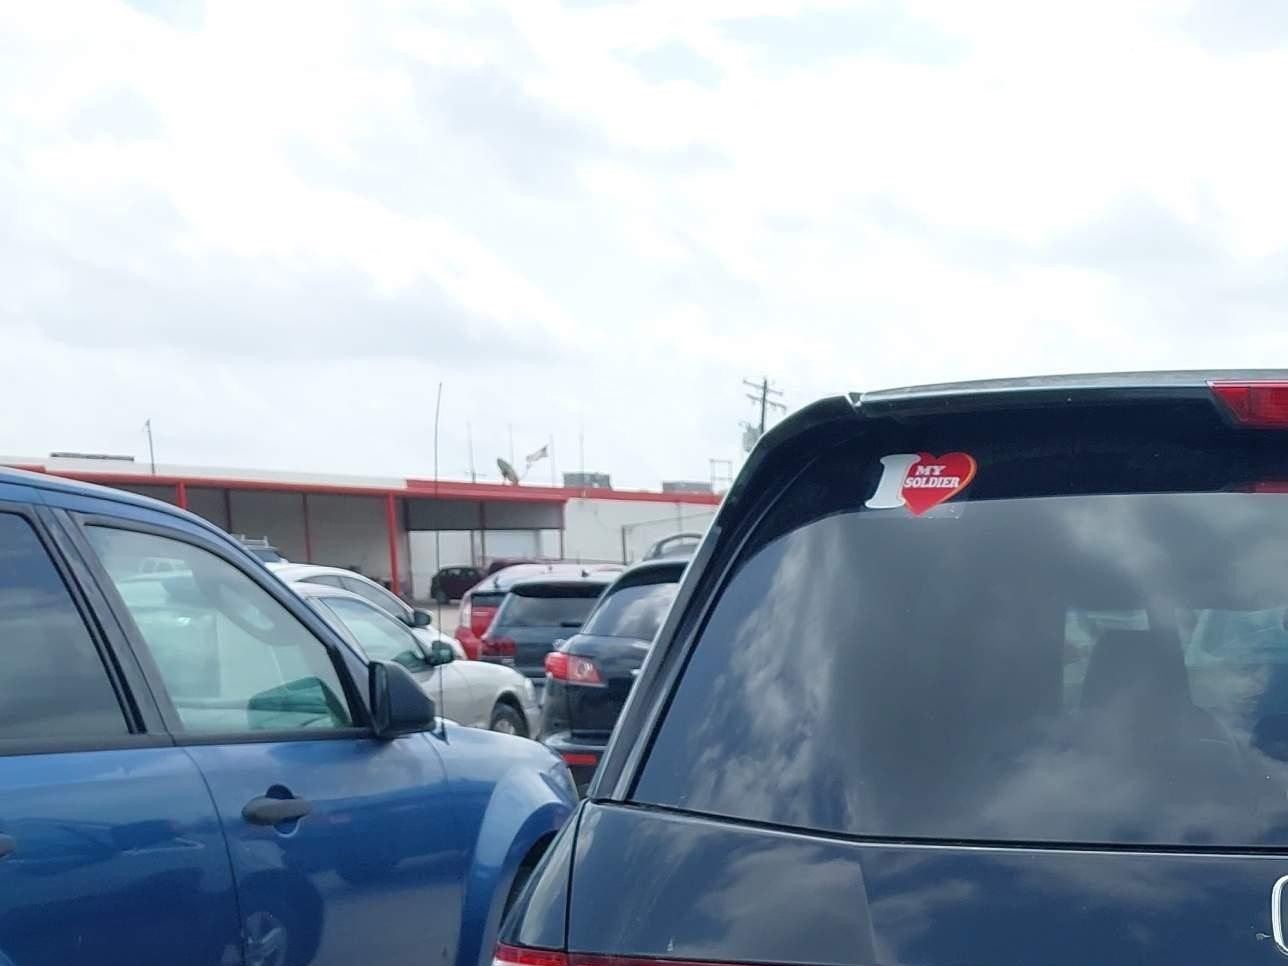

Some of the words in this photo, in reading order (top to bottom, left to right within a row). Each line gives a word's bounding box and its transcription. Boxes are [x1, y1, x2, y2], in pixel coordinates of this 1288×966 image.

[915, 465, 946, 477] MY
[865, 453, 921, 509] I
[903, 476, 961, 489] SOLDIER
